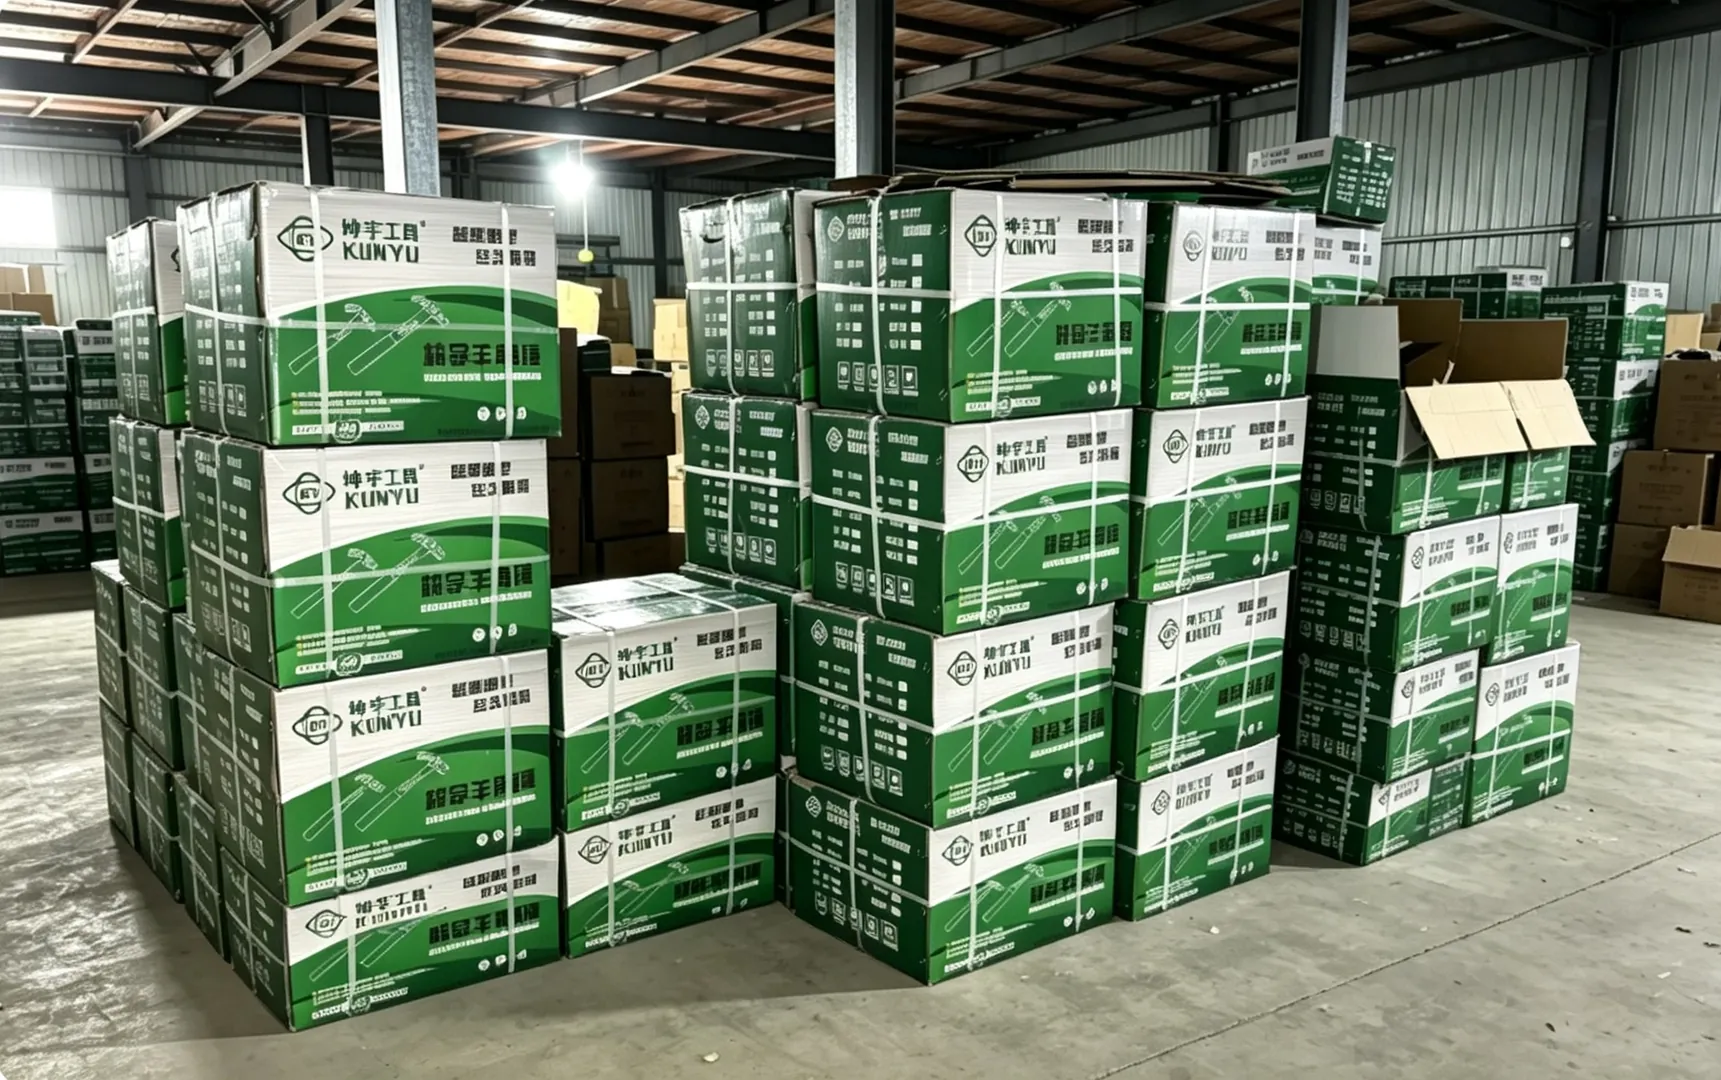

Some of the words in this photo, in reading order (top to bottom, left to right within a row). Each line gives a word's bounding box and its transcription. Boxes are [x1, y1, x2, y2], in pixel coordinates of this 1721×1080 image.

[342, 241, 419, 263] KUNYU
[345, 487, 419, 510] KUNYU
[350, 710, 422, 737] KUNYU
